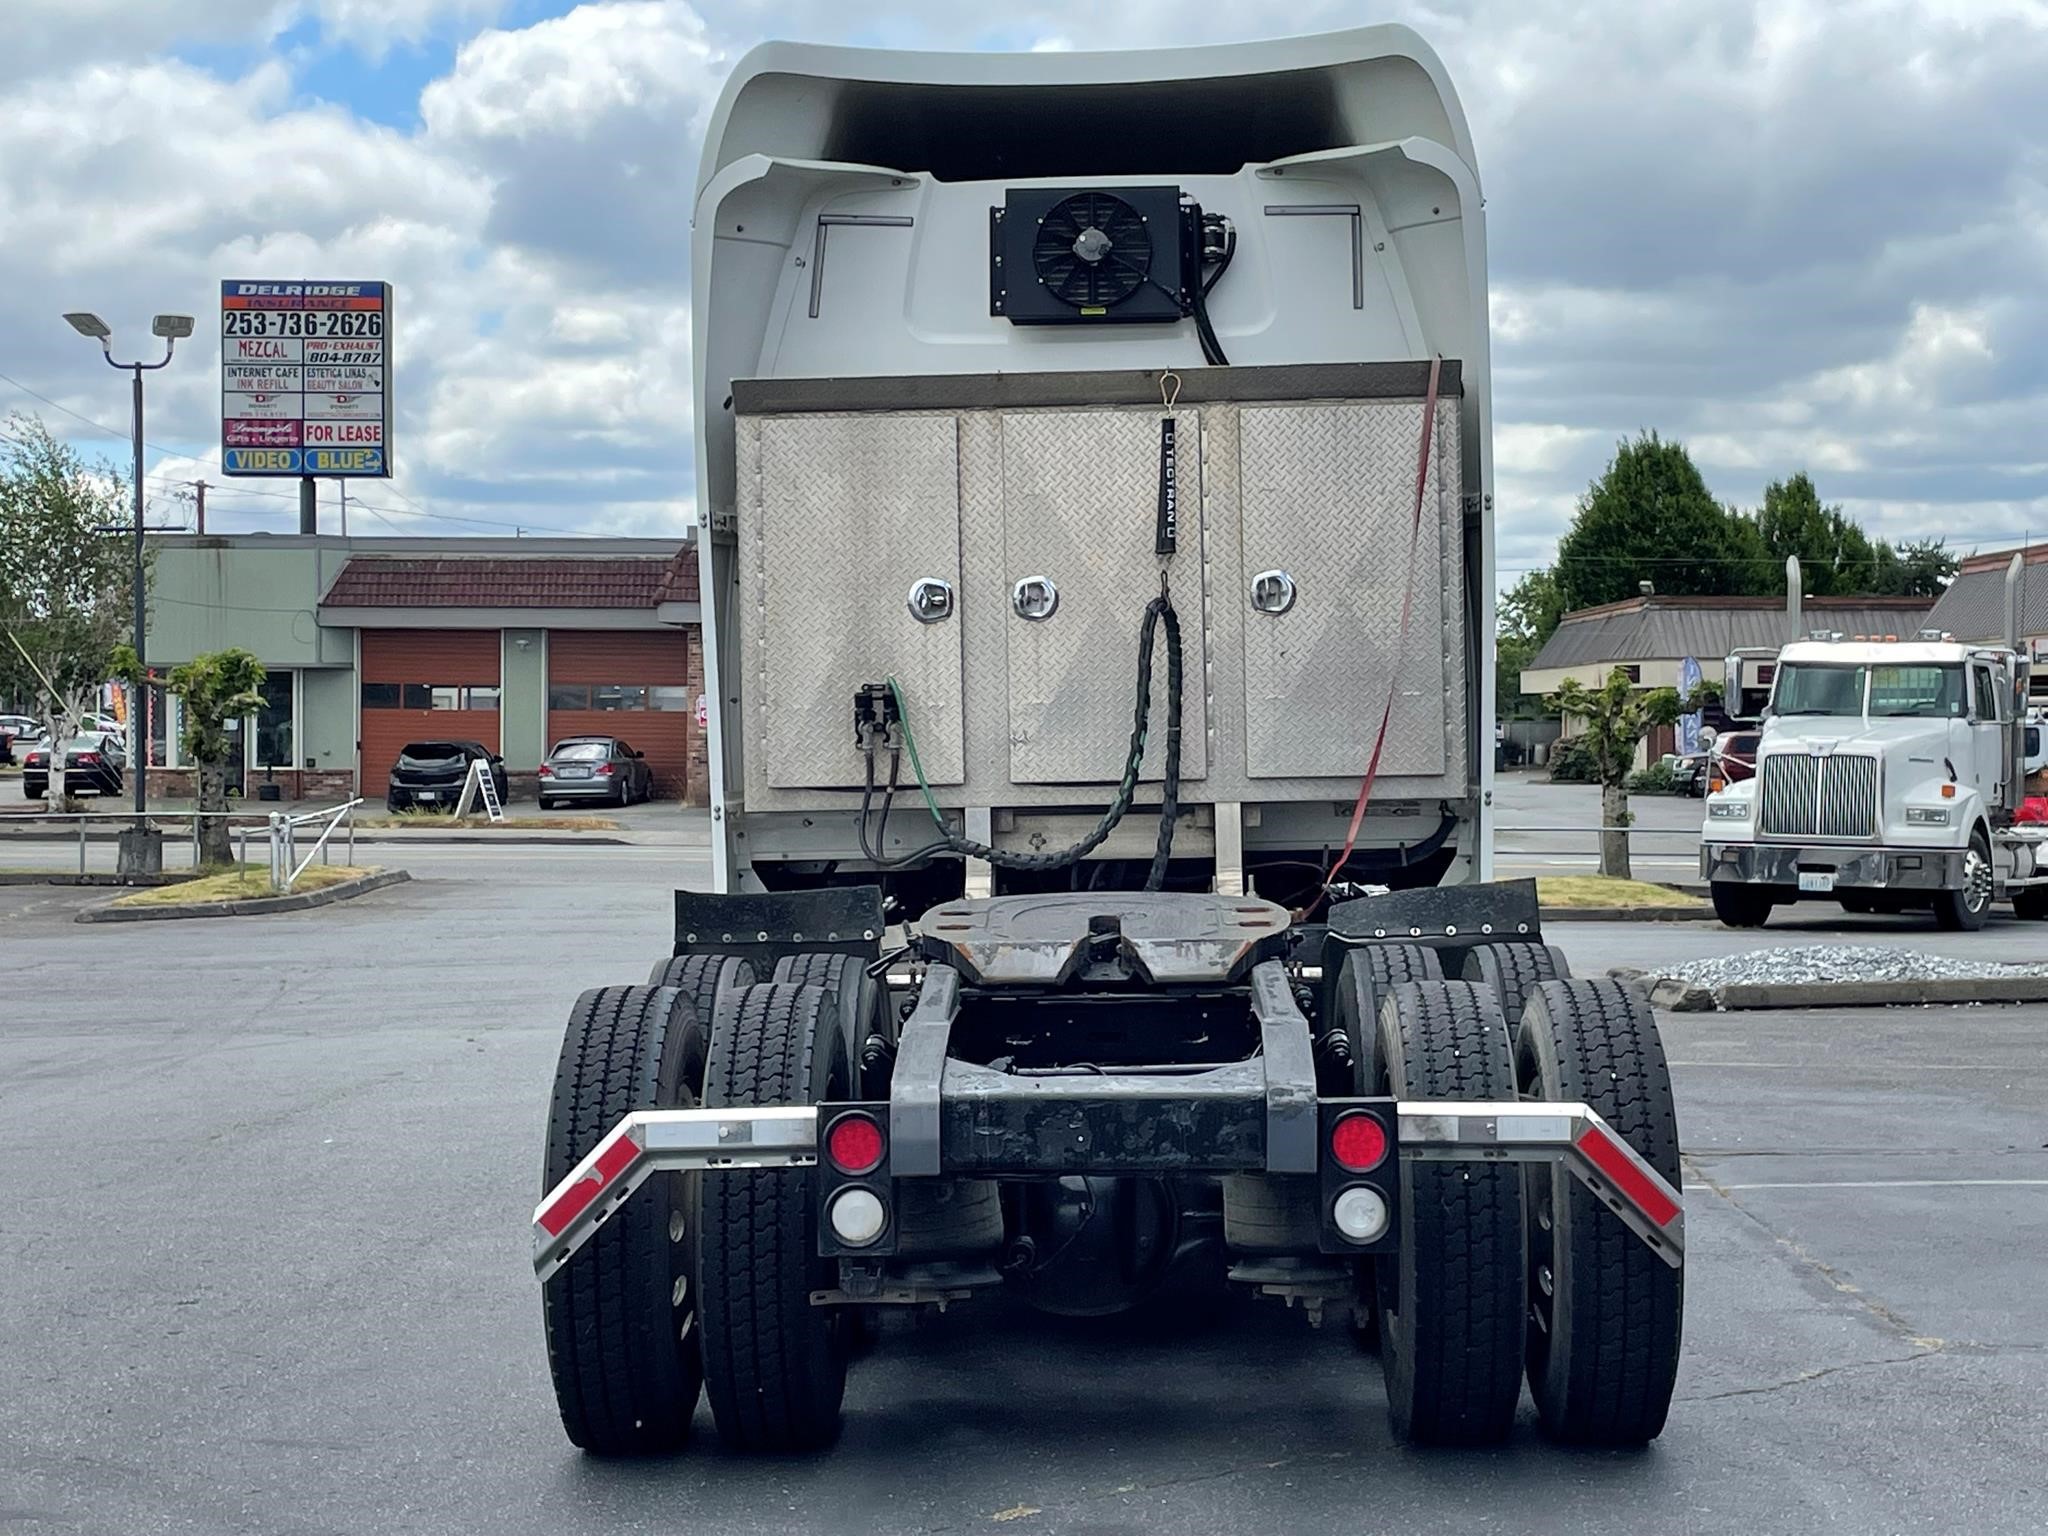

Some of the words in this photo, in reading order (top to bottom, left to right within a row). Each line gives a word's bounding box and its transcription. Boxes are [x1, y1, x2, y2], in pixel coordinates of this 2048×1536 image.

[238, 284, 361, 296] DELRIDGE
[246, 299, 350, 308] INSURANCE
[225, 312, 381, 336] 253-736-2626
[238, 340, 288, 358] MEZCAL
[228, 367, 273, 378] INTERNET
[275, 367, 299, 378] CAFE
[307, 368, 342, 378] ESTETICA
[237, 379, 254, 390] INK
[257, 379, 288, 390] REFILL
[307, 380, 336, 391] BEAUTY
[338, 380, 363, 391] SALON
[306, 425, 333, 441] FOR
[338, 425, 381, 441] LEASE
[235, 451, 291, 469] VIDEO
[1166, 447, 1175, 523] TECTRAN
